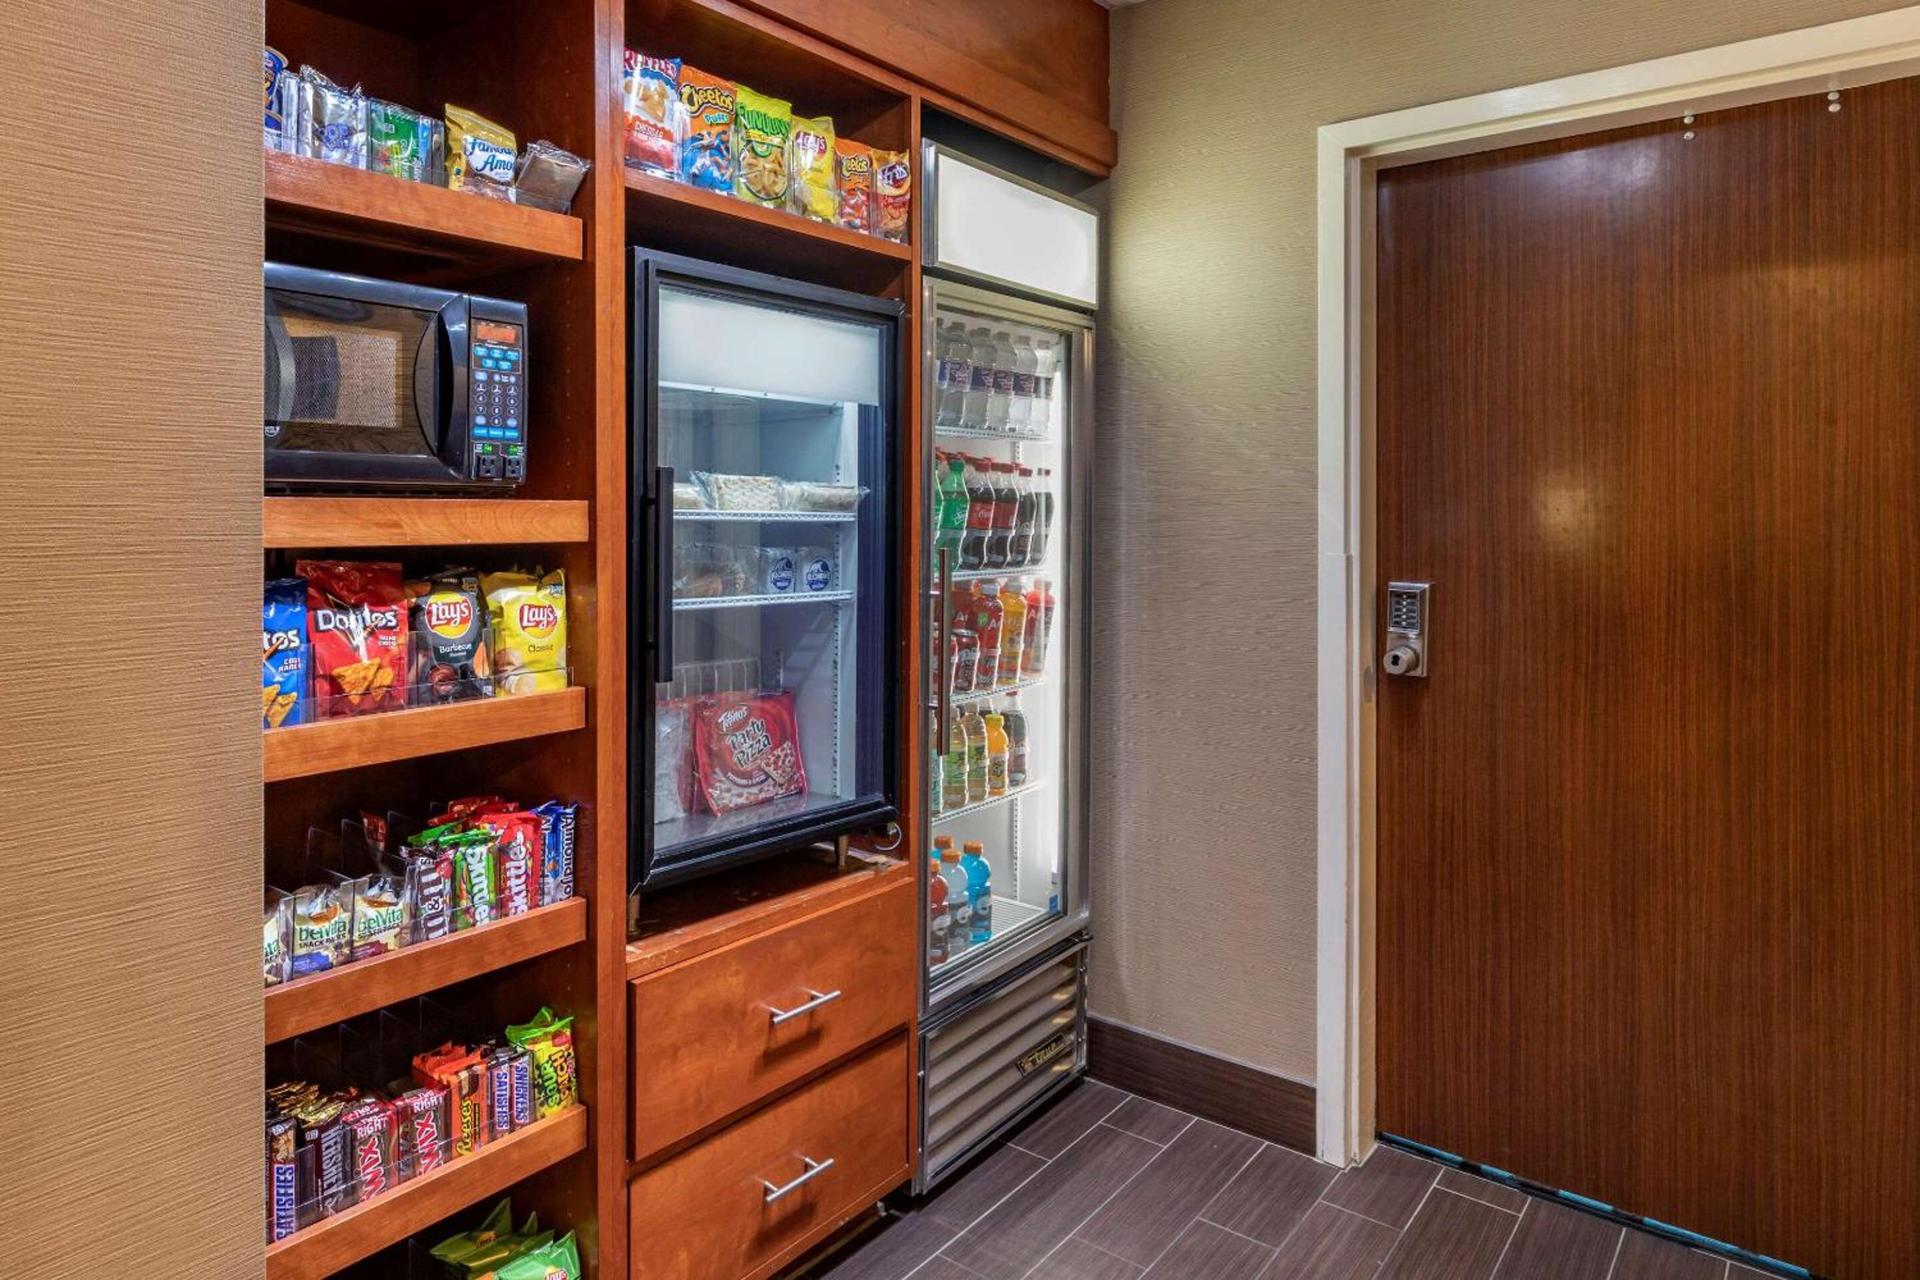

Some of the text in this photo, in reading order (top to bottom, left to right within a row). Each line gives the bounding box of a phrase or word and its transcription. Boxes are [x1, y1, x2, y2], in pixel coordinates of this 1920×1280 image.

[682, 85, 734, 112] Cheetos
[730, 719, 766, 749] Party
[735, 734, 771, 769] Pizza
[541, 1060, 560, 1107] SOUR
[356, 1116, 387, 1140] RIGHT
[457, 1099, 472, 1155] Reese's
